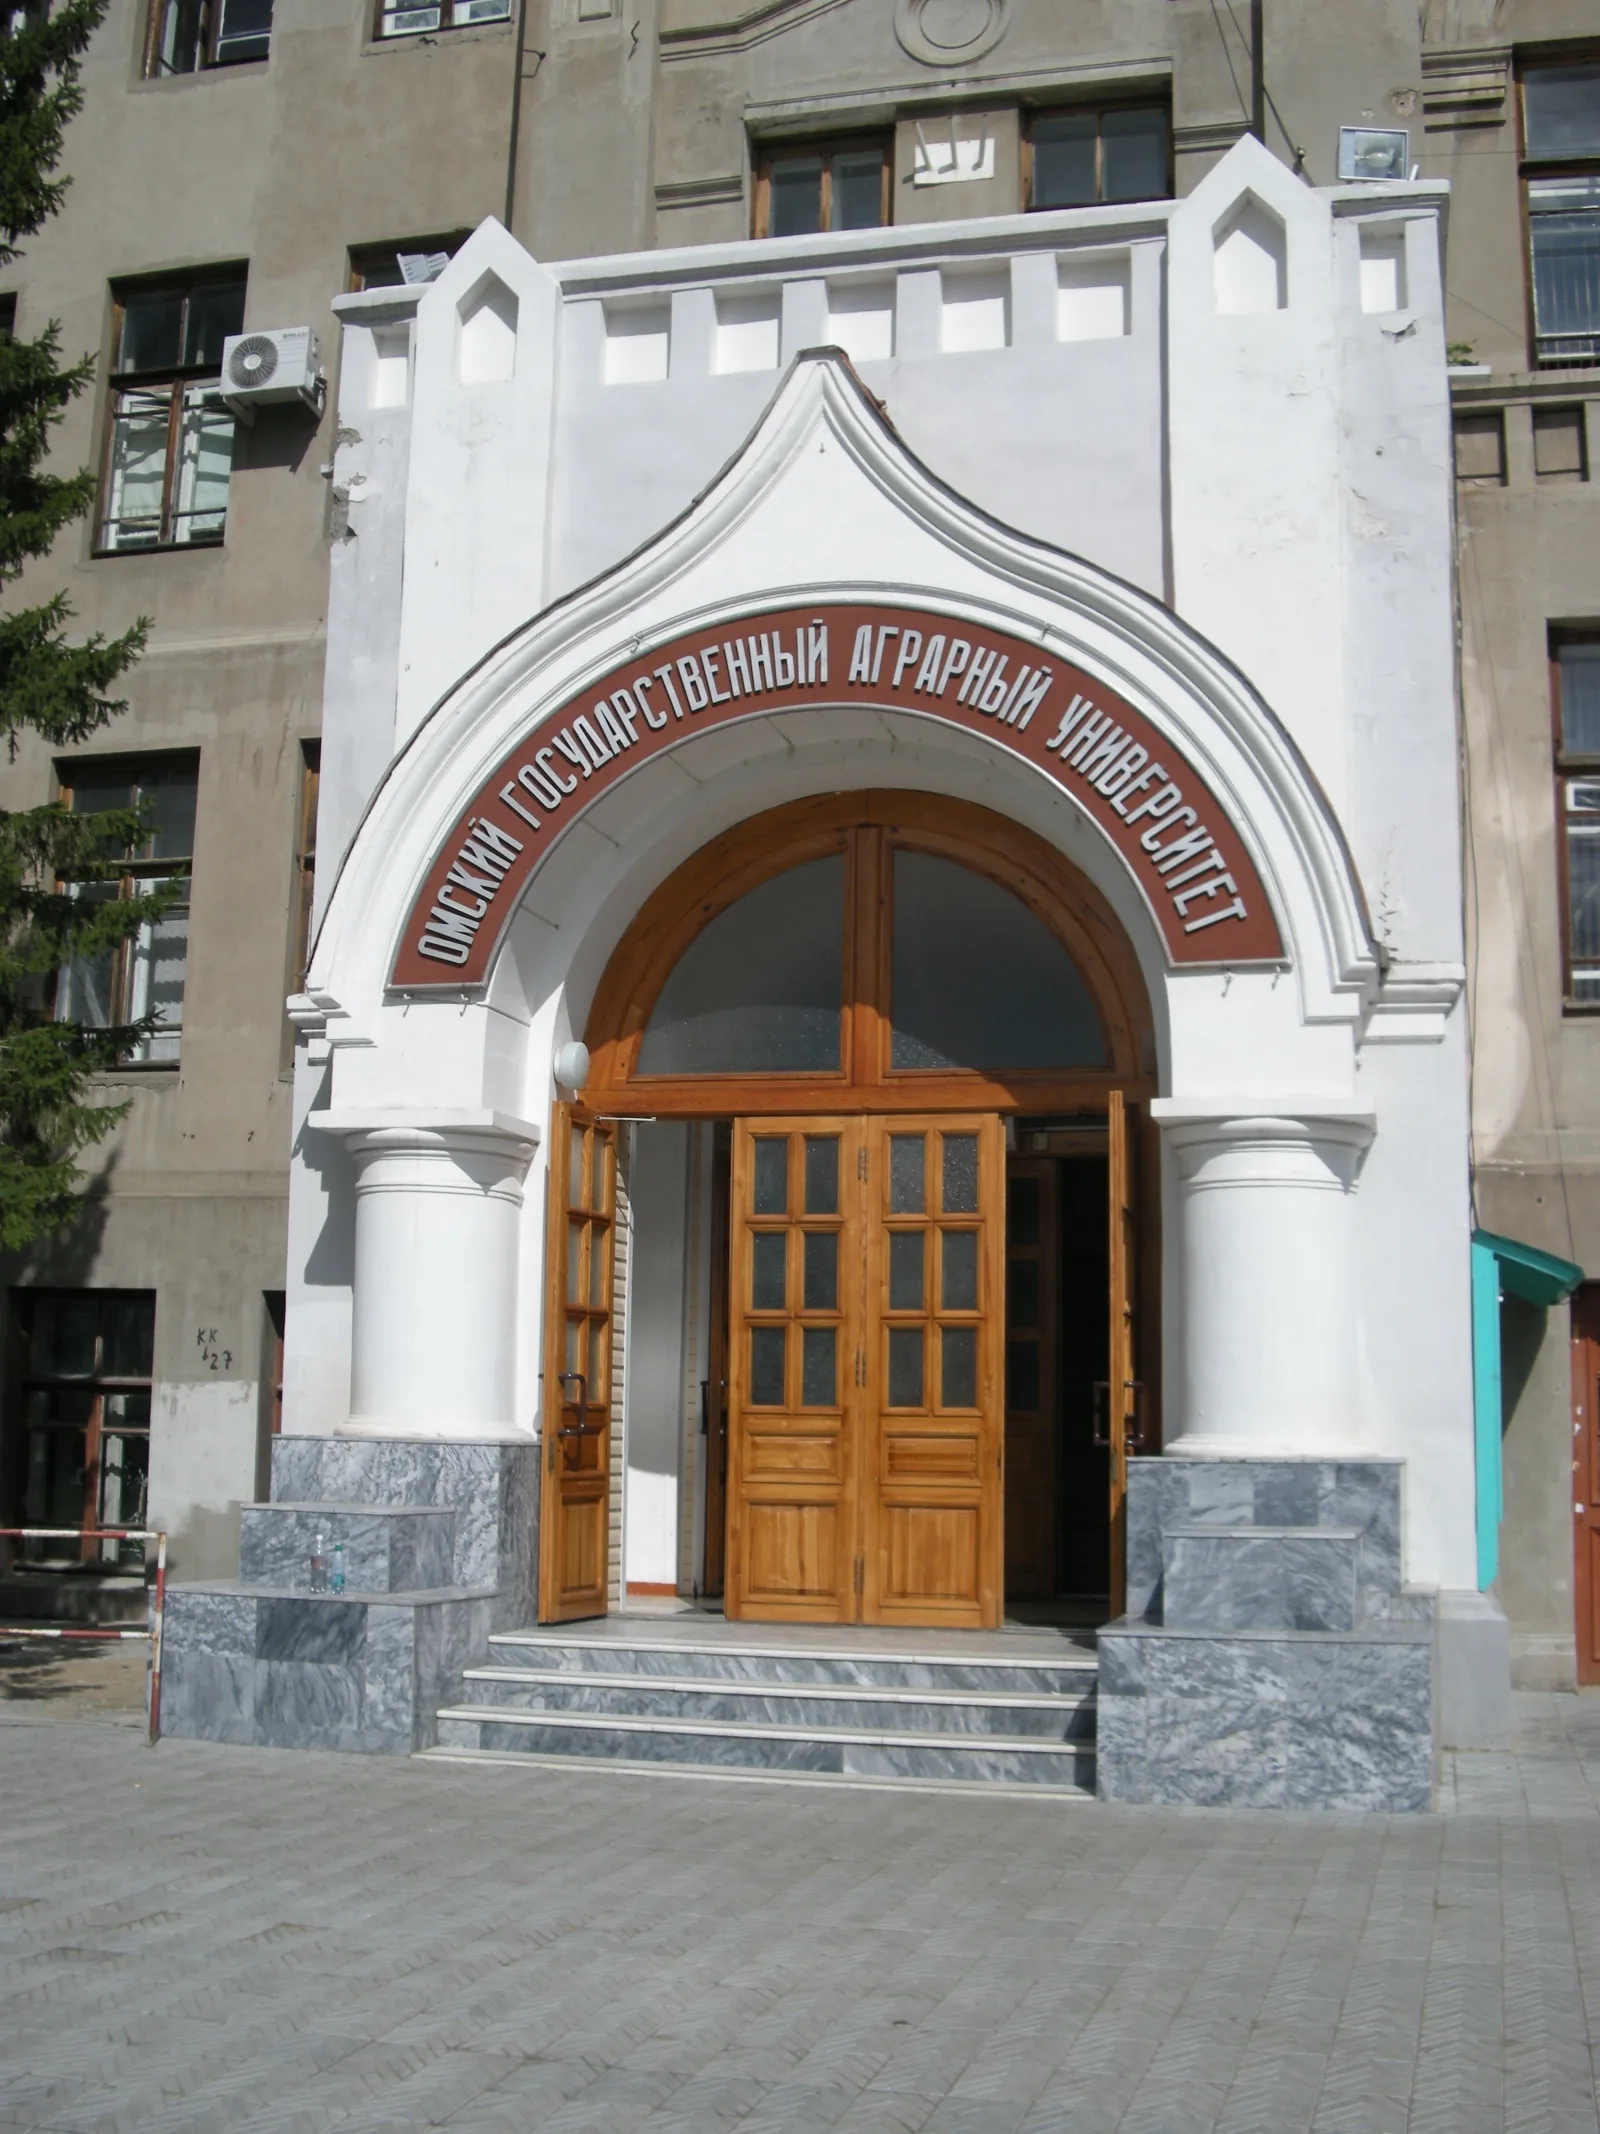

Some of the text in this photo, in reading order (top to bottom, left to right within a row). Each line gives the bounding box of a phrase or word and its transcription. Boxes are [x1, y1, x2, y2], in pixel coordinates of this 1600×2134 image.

[418, 619, 1247, 964] ОМСКИЙ ГОСУДАРСТВЕННЫЙ АГРАРНЫЙ УНИВЕРСИТЕТ
[209, 1350, 233, 1370] 27
